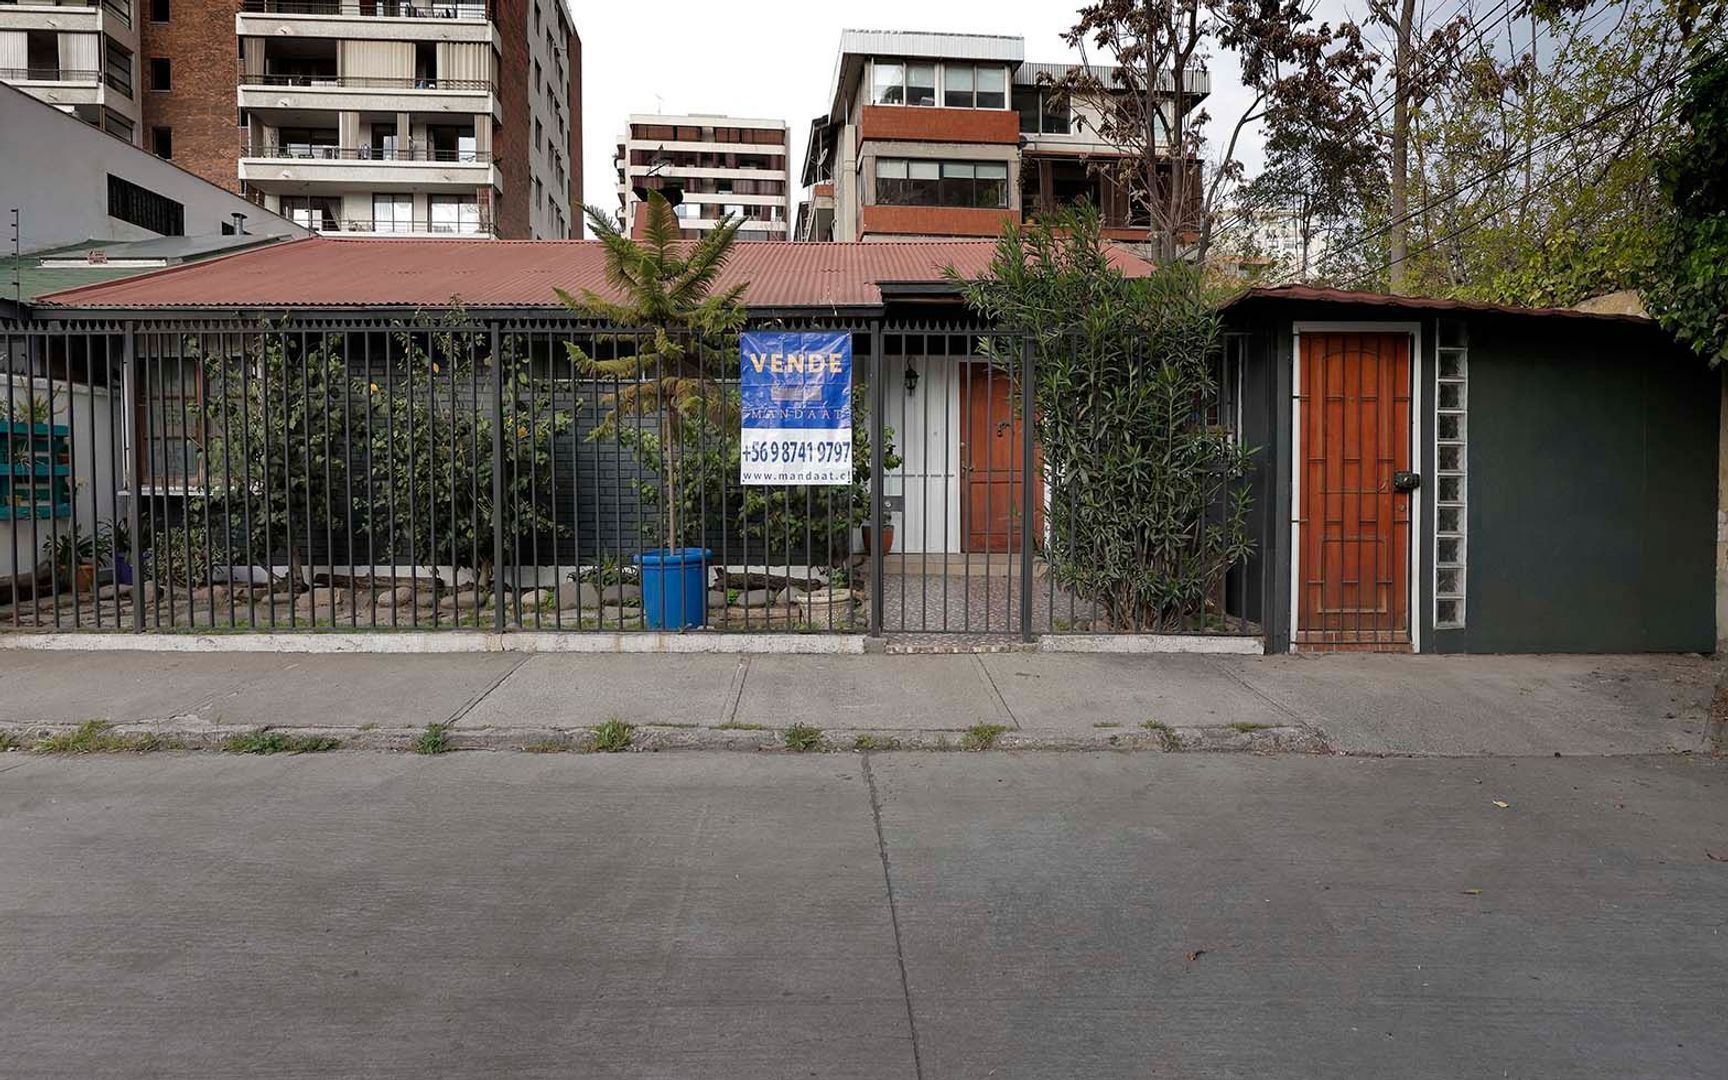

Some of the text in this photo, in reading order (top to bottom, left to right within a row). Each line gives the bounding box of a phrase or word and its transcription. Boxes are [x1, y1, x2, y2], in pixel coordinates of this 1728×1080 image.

[750, 353, 843, 373] VENDE
[751, 409, 843, 419] MANDAAT
[742, 441, 850, 462] +56 9 8741 9797
[743, 471, 850, 480] www.mandaat.cl
